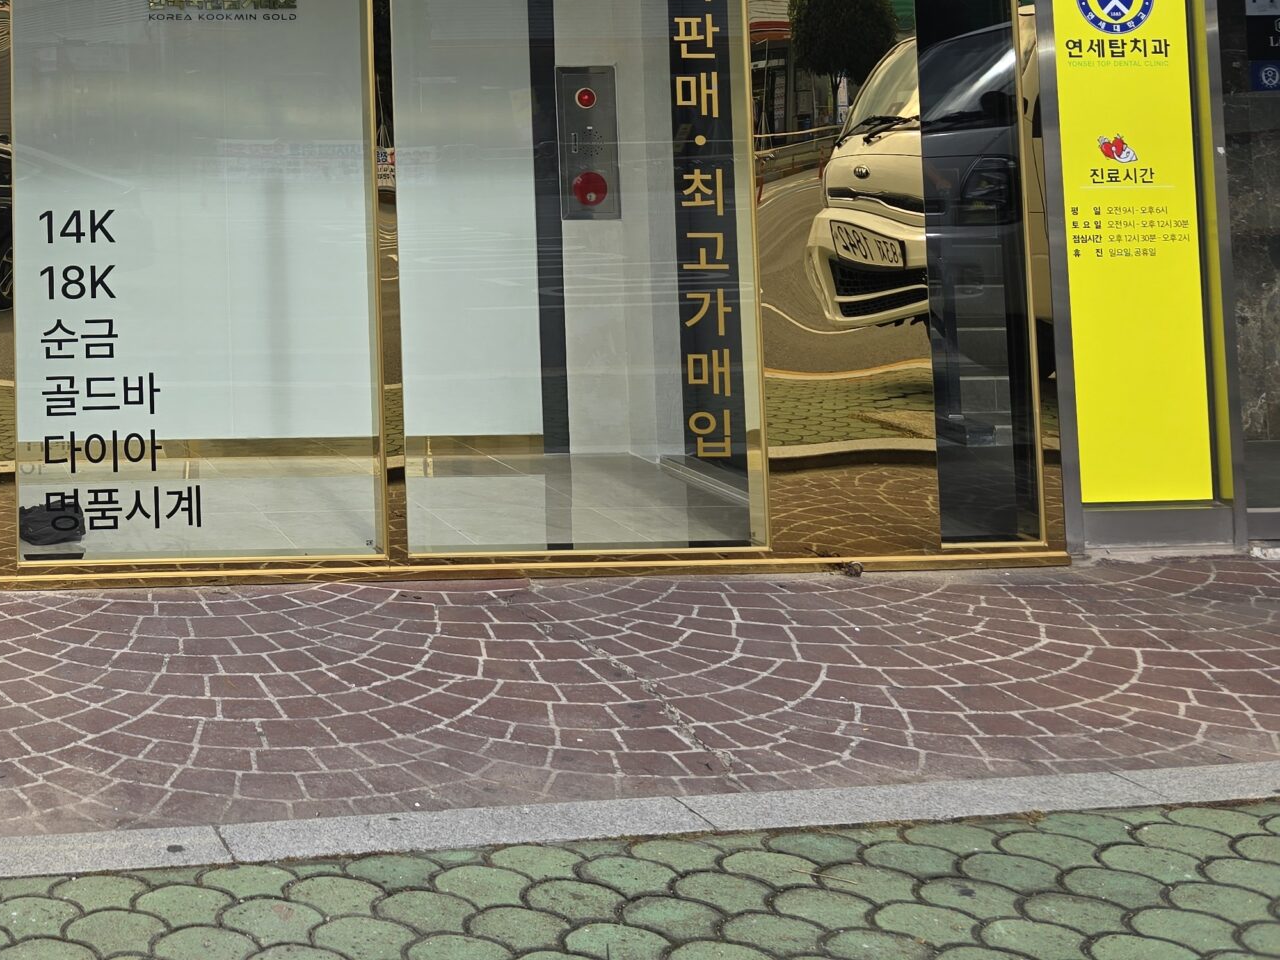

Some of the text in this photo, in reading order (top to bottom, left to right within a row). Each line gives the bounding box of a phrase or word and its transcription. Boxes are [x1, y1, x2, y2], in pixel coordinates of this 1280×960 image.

[198, 13, 257, 21] KOOKMIN
[262, 13, 297, 21] GOLD
[1065, 38, 1170, 58] 연세탑치과
[1090, 168, 1154, 184] 진료시간
[39, 210, 116, 243] 14K
[39, 265, 117, 300] 18K
[40, 318, 119, 359] 순금
[41, 372, 161, 417] 골드바
[44, 429, 162, 474] 다이아
[45, 485, 202, 532] 명품시계
